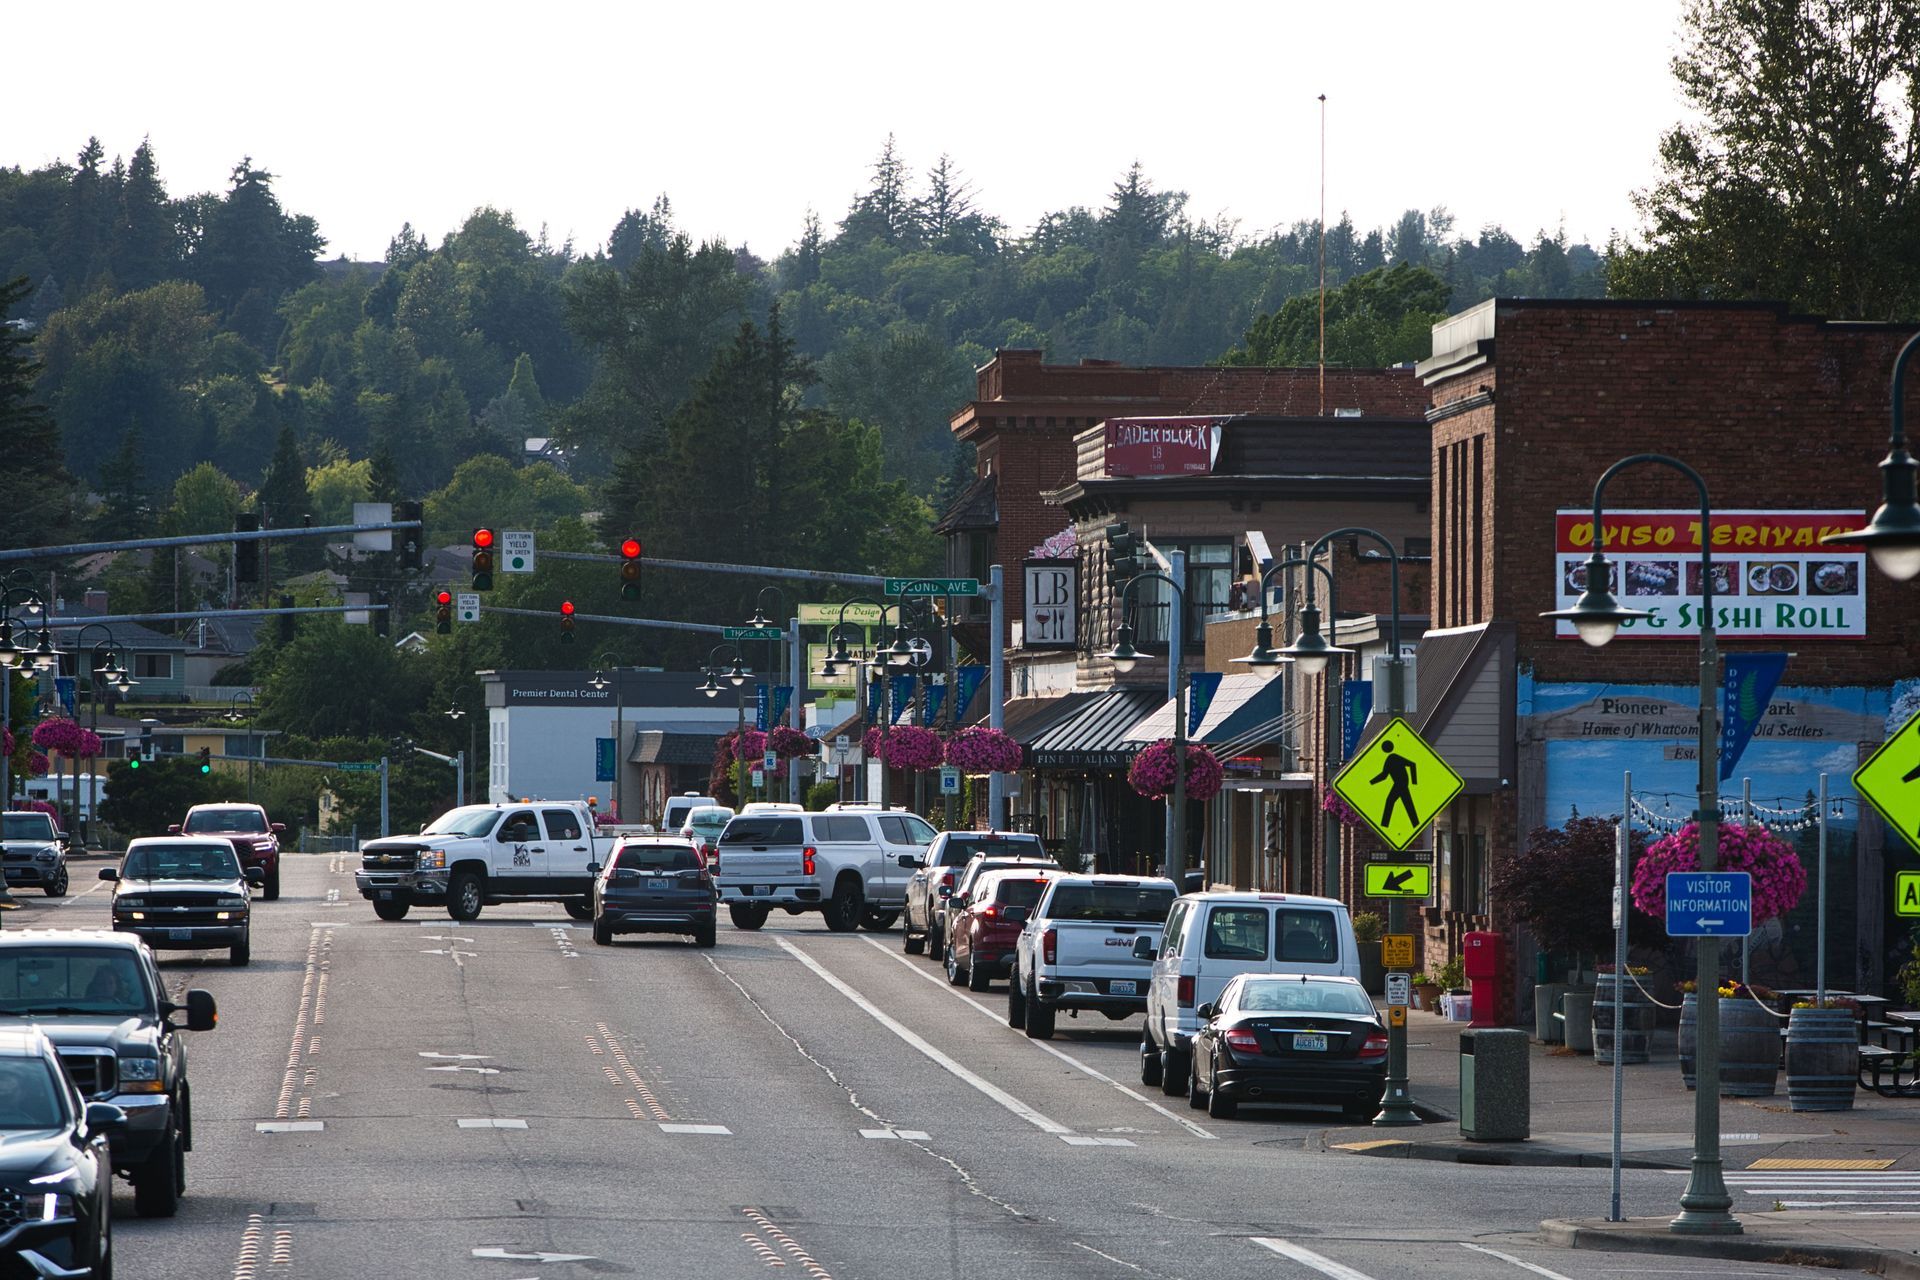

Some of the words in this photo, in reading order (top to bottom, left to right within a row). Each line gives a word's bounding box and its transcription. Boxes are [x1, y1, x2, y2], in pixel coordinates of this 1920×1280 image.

[1162, 423, 1207, 450] BLOCK
[1688, 521, 1855, 547] TERIYAK
[1032, 572, 1069, 606] LB
[512, 688, 548, 698] Premier
[549, 689, 579, 699] Dental
[580, 690, 609, 699] Center
[1602, 698, 1668, 715] Pioneer
[1768, 701, 1796, 716] ark
[1725, 668, 1738, 760] DOWNTOWN
[1344, 690, 1352, 749] DOWNTOWN
[1581, 721, 1621, 736] Home
[1623, 722, 1640, 739] of
[1641, 722, 1699, 736] Whatcom
[1777, 723, 1824, 737] Settlers
[1038, 755, 1065, 764] FINE
[1686, 880, 1732, 894] VISITOR
[1669, 899, 1748, 913] INFORMATION
[1104, 937, 1135, 947] GM
